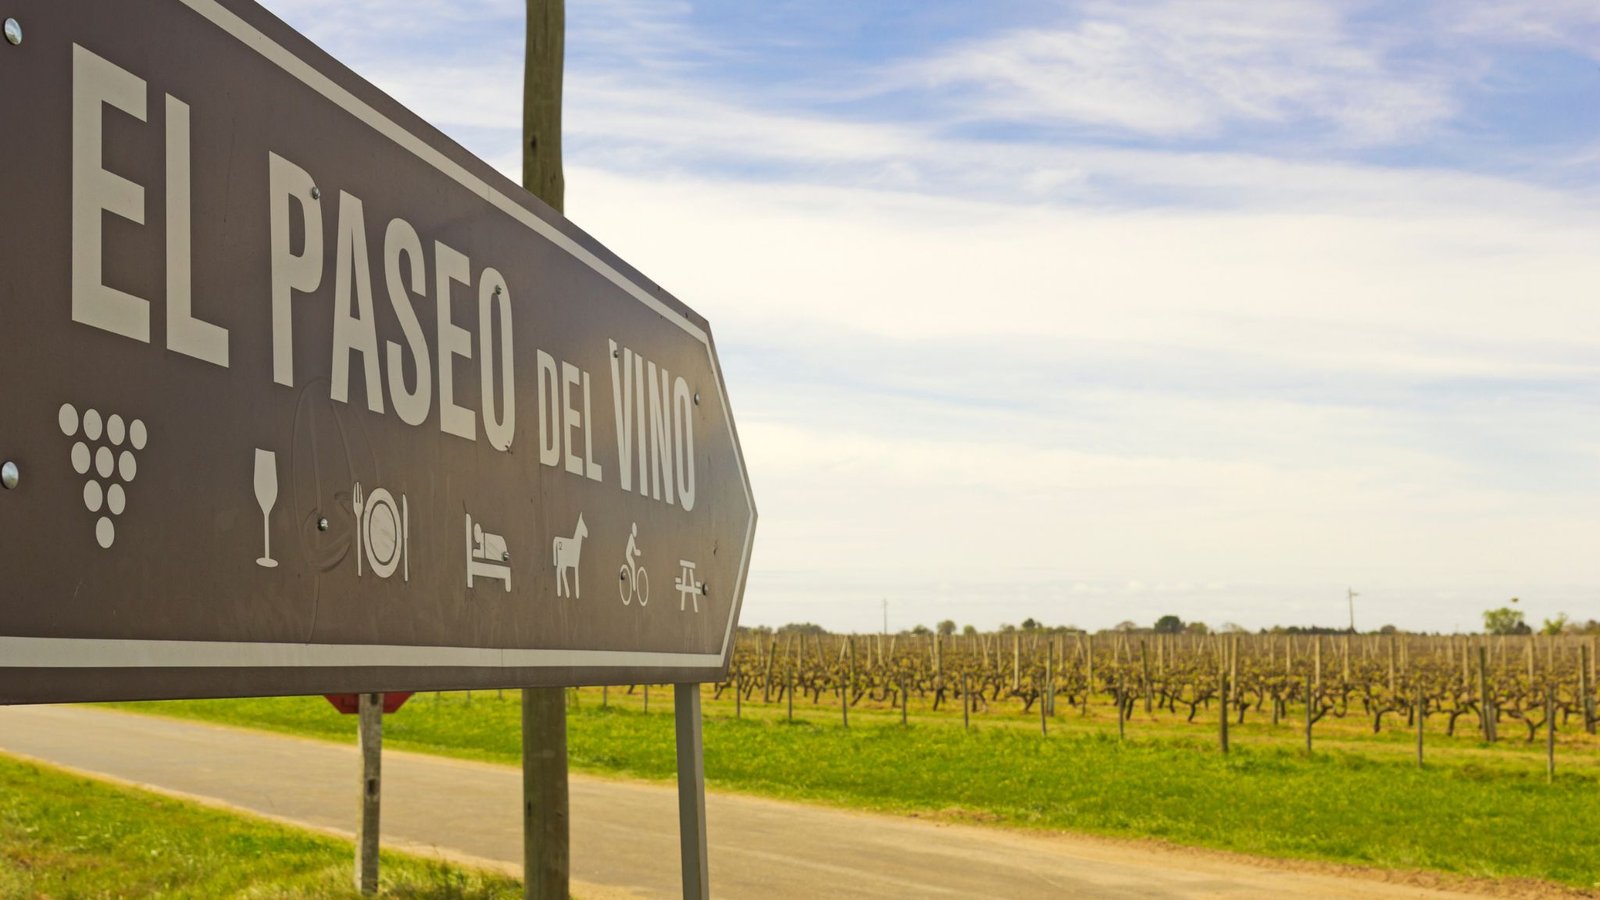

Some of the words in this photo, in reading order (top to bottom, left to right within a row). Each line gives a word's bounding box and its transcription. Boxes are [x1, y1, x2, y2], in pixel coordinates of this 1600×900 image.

[72, 42, 229, 367] EL
[269, 151, 515, 451] PASEO
[537, 350, 602, 482] DEL
[609, 339, 696, 512] VINO
